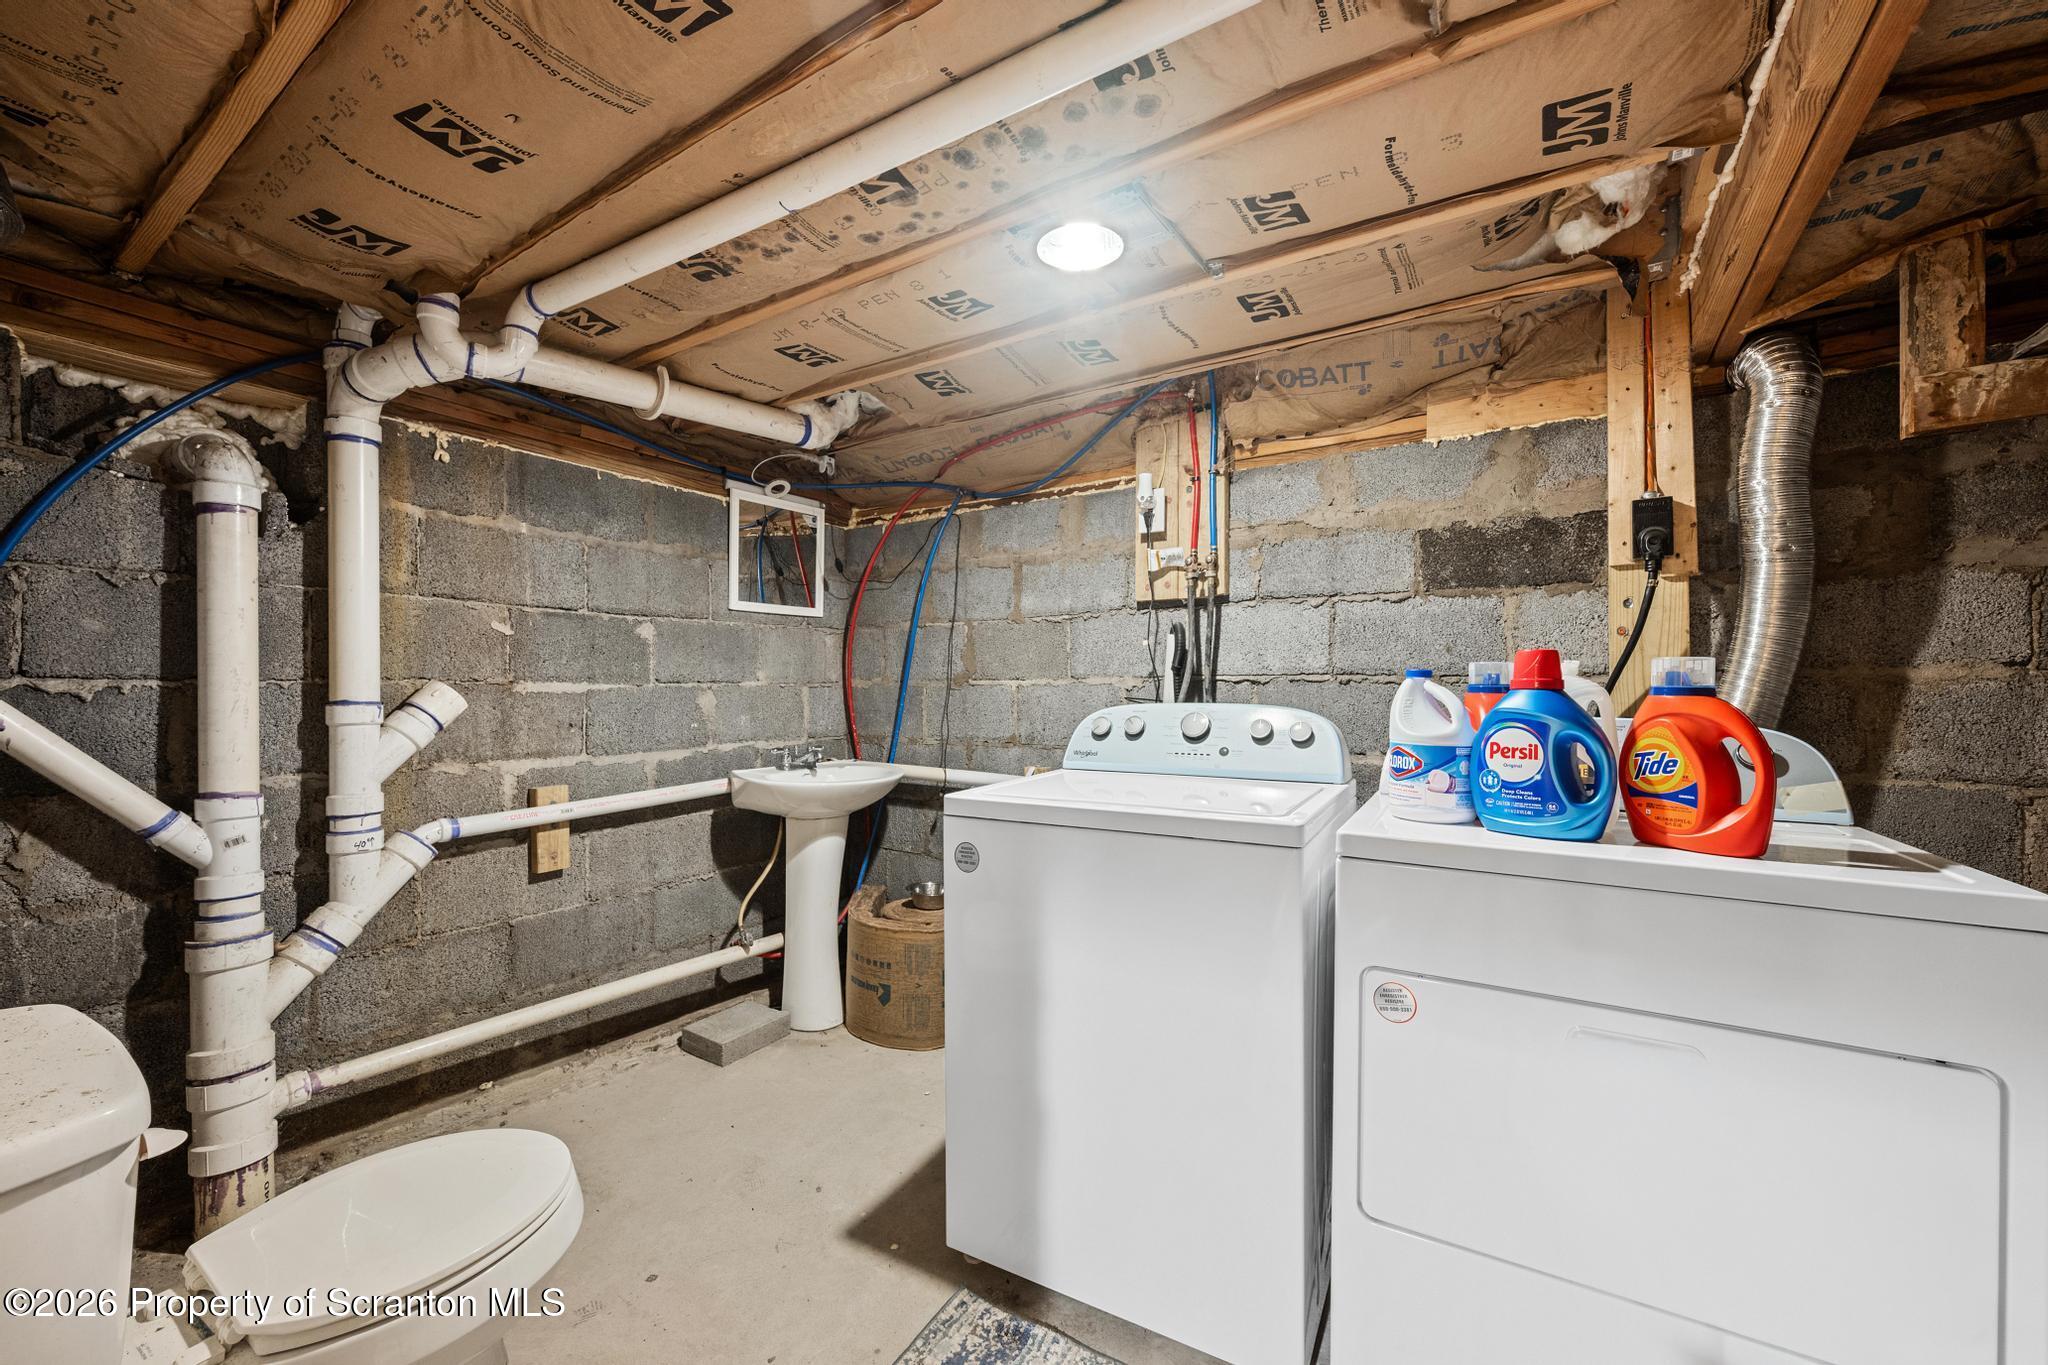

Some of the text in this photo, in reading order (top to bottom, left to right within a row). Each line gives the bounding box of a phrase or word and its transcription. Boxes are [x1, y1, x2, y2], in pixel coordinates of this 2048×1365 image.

[513, 40, 562, 78] Sound
[560, 74, 589, 95] and
[432, 99, 497, 143] Manville
[1542, 88, 1614, 156] JM
[393, 102, 525, 174] JM
[1242, 190, 1311, 233] JM
[296, 207, 412, 257] JM
[926, 289, 995, 320] JM
[1236, 289, 1291, 323] JM
[774, 343, 841, 368] JM
[914, 369, 966, 398] JM
[1073, 748, 1099, 759] Whirlpool
[1388, 754, 1416, 770] LOROX
[1489, 741, 1539, 761] Persil
[1632, 750, 1680, 782] Tide
